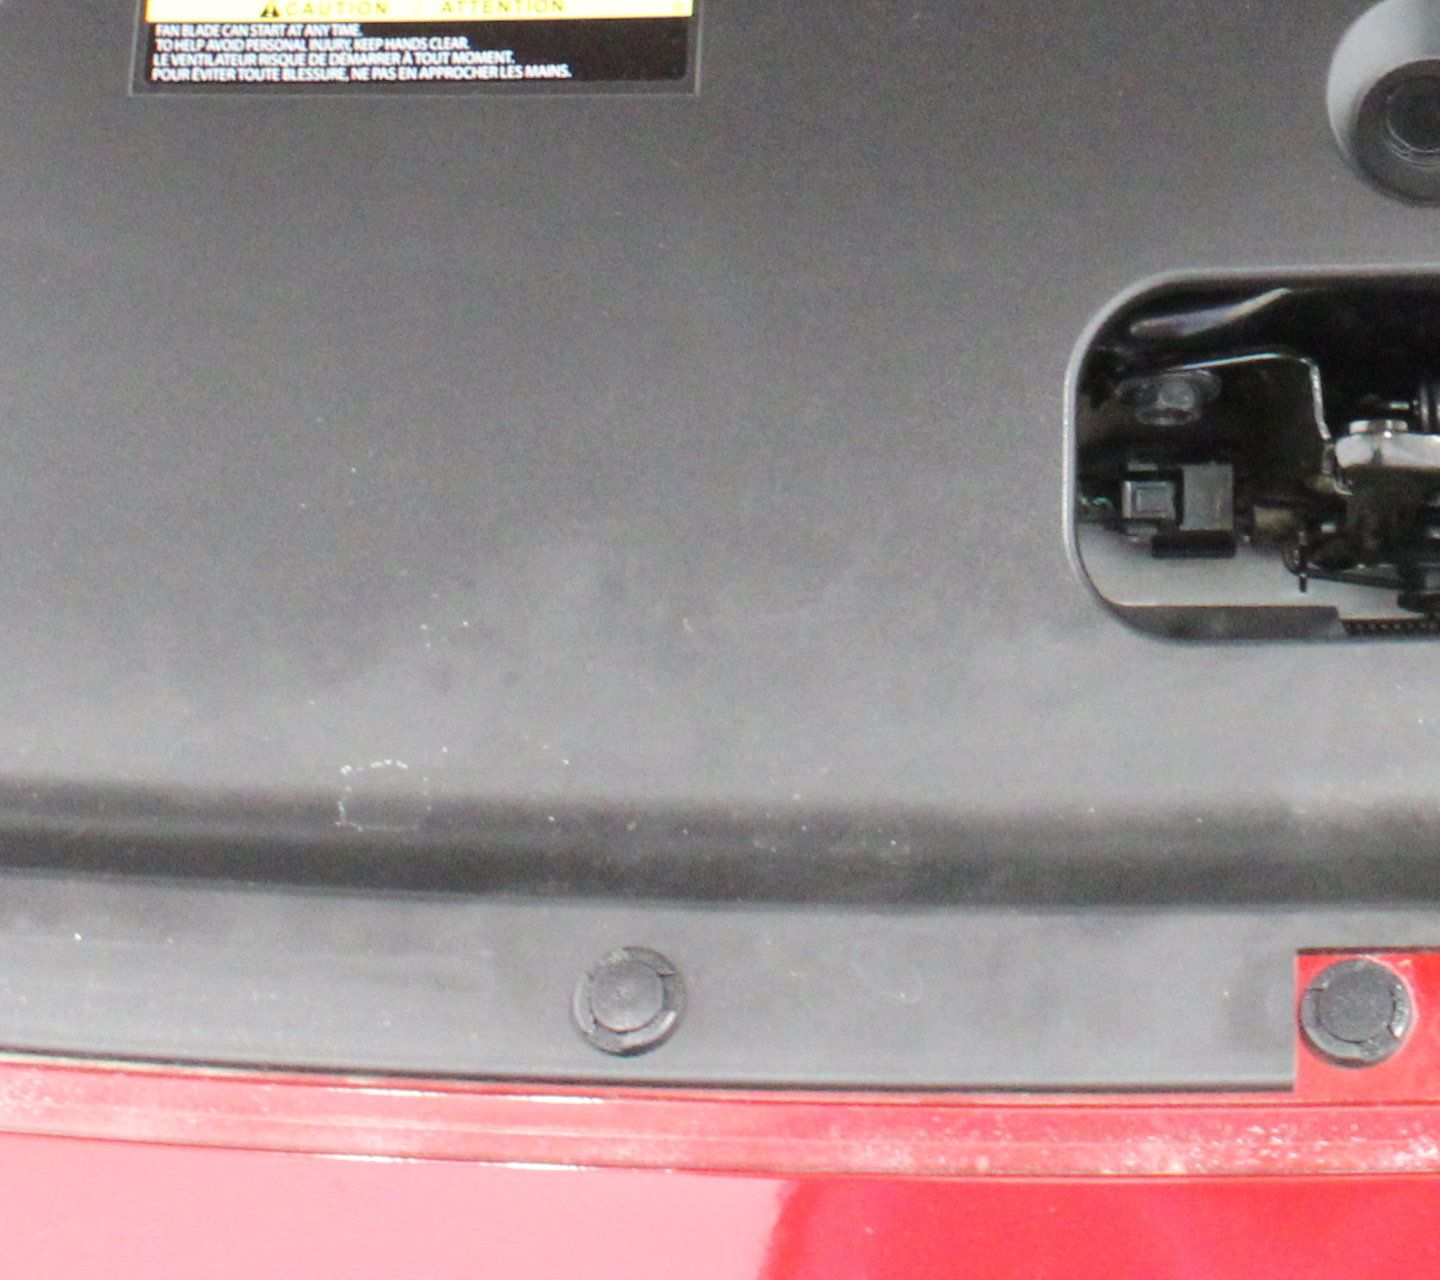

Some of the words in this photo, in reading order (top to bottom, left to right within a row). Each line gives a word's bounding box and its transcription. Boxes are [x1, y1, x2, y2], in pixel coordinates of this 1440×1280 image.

[285, 1, 389, 16] CAUTION
[440, 0, 566, 14] ATTENTION
[155, 23, 181, 37] FAN
[182, 23, 221, 37] BLADE
[221, 23, 249, 37] CAN
[250, 23, 286, 37] START
[287, 23, 303, 37] AT
[303, 23, 331, 37] ANY
[155, 38, 174, 52] TO
[174, 38, 205, 52] HELP
[206, 38, 245, 52] AVOID
[245, 38, 307, 52] PERSONAL
[353, 37, 384, 51] KEEP
[384, 37, 426, 51] HANDS
[153, 52, 170, 67] LE
[170, 52, 258, 67] VENTILATEUR
[258, 52, 308, 67] RISQUE
[308, 52, 328, 67] DE
[414, 51, 451, 66] TOUT
[151, 67, 189, 82] POUR
[237, 67, 281, 82] TOUTE
[350, 66, 371, 81] NE
[371, 66, 397, 81] PAS
[397, 66, 418, 81] EN
[418, 66, 500, 81] APPROCHER
[500, 65, 524, 80] LES
